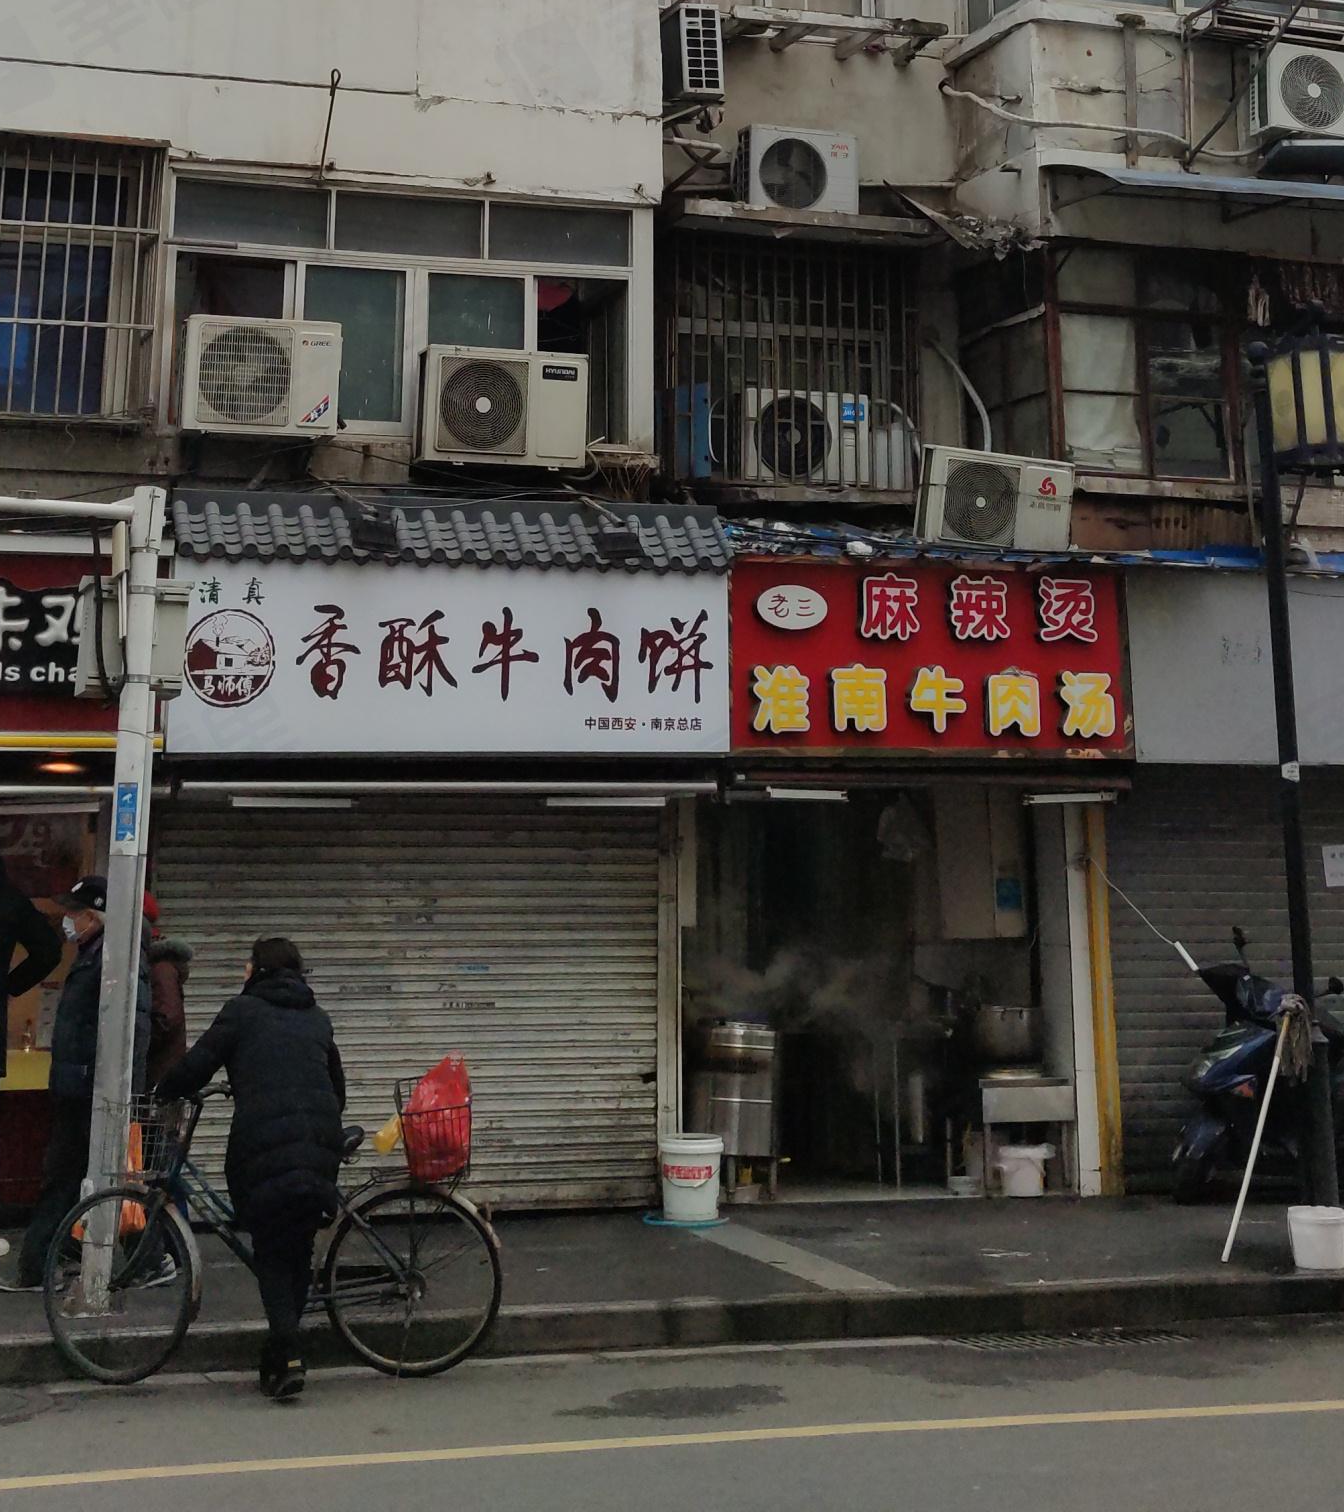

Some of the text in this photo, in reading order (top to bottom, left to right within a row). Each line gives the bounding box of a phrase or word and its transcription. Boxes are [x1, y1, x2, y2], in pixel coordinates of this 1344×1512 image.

[198, 576, 267, 606] 清真
[767, 592, 816, 619] 老三
[860, 572, 1098, 643] 麻辣烫
[295, 604, 713, 704] 香酥牛肉饼
[200, 674, 255, 698] 马师傅
[752, 663, 1117, 738] 淮南牛肉汤
